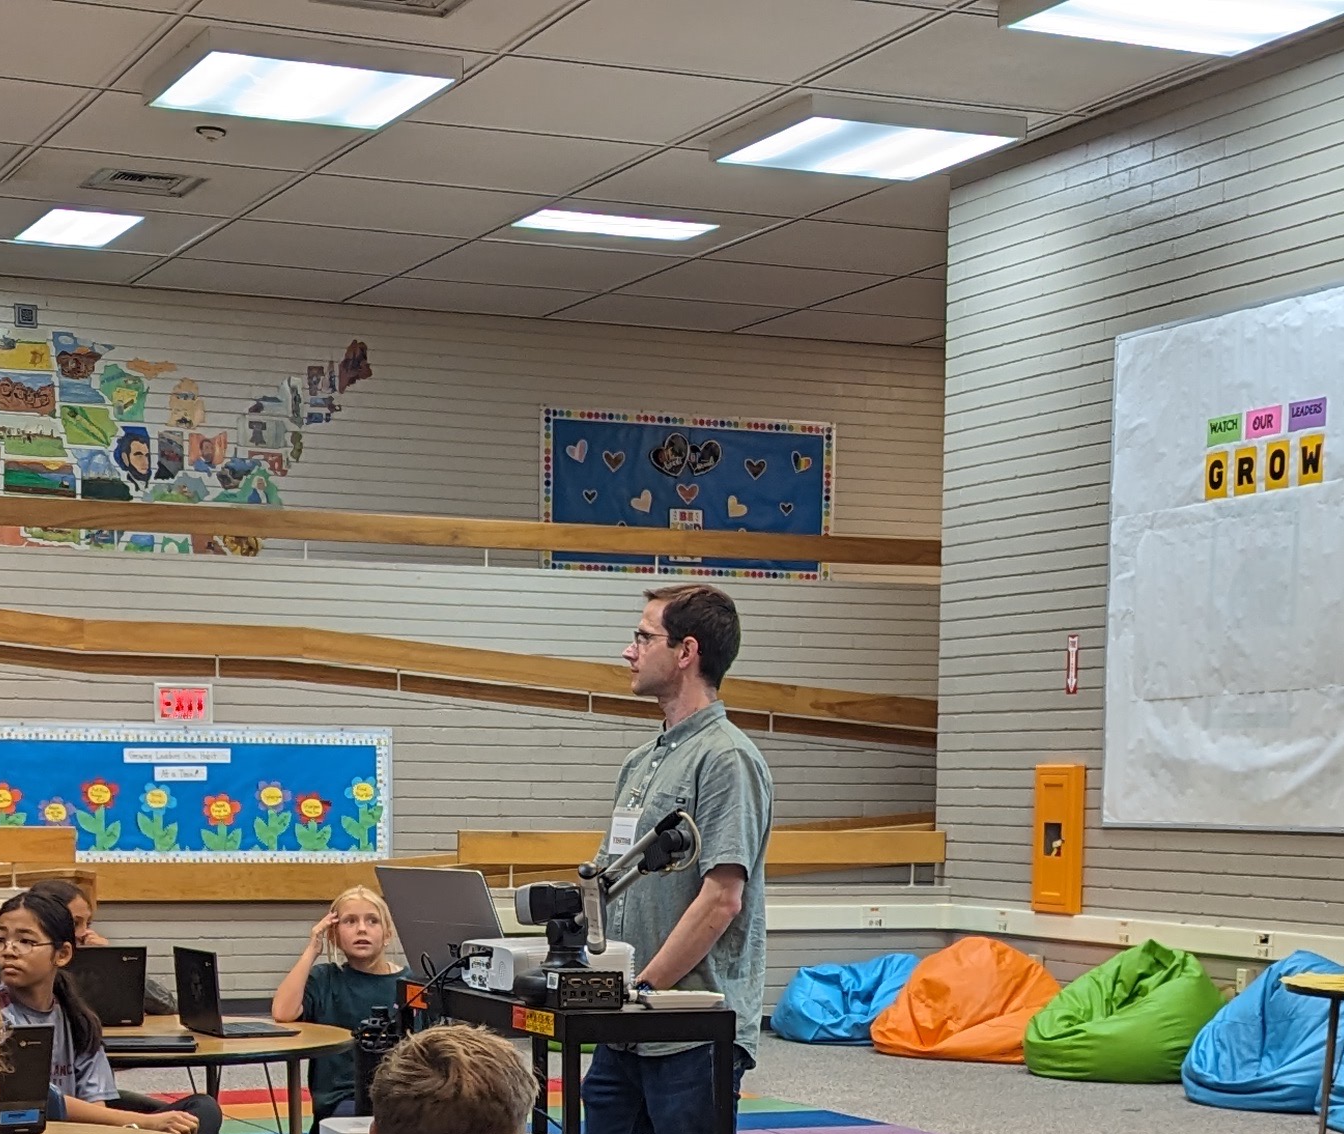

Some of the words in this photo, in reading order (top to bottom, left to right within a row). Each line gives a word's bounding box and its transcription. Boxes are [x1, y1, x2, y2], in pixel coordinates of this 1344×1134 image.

[1210, 419, 1238, 434] WATCH
[1252, 414, 1274, 430] OUR
[1291, 403, 1322, 418] LEADERS
[1209, 443, 1322, 490] GROW
